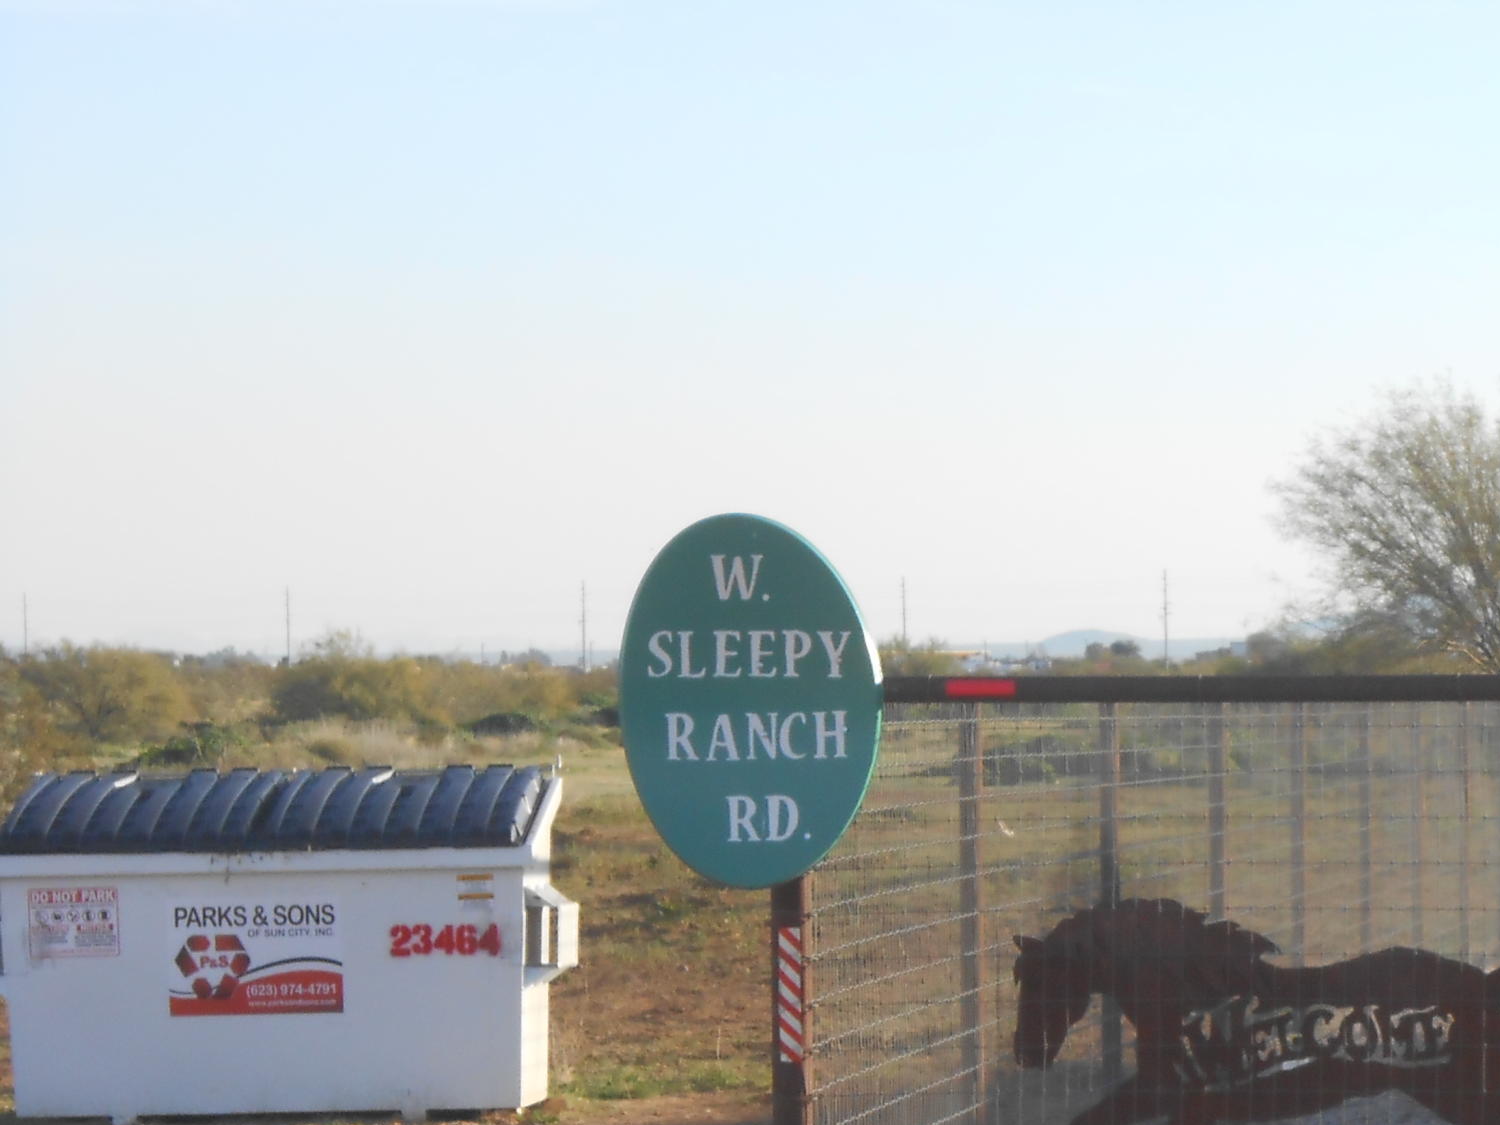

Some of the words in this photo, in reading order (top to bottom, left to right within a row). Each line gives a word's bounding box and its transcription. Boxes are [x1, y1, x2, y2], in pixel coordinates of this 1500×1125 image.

[712, 553, 770, 602] W.
[647, 629, 852, 679] SLEEPY
[665, 710, 848, 762] RANCH
[725, 794, 812, 843] RD.
[31, 890, 48, 903] DO
[52, 889, 76, 903] NOT
[81, 888, 115, 902] PARK
[173, 906, 247, 928] PARKS
[253, 905, 269, 926] &
[273, 904, 335, 925] SONS
[247, 928, 260, 937] OF
[264, 928, 286, 937] SUN
[390, 924, 501, 957] 23464
[246, 984, 278, 997] (623)
[280, 983, 337, 995] 974-4791
